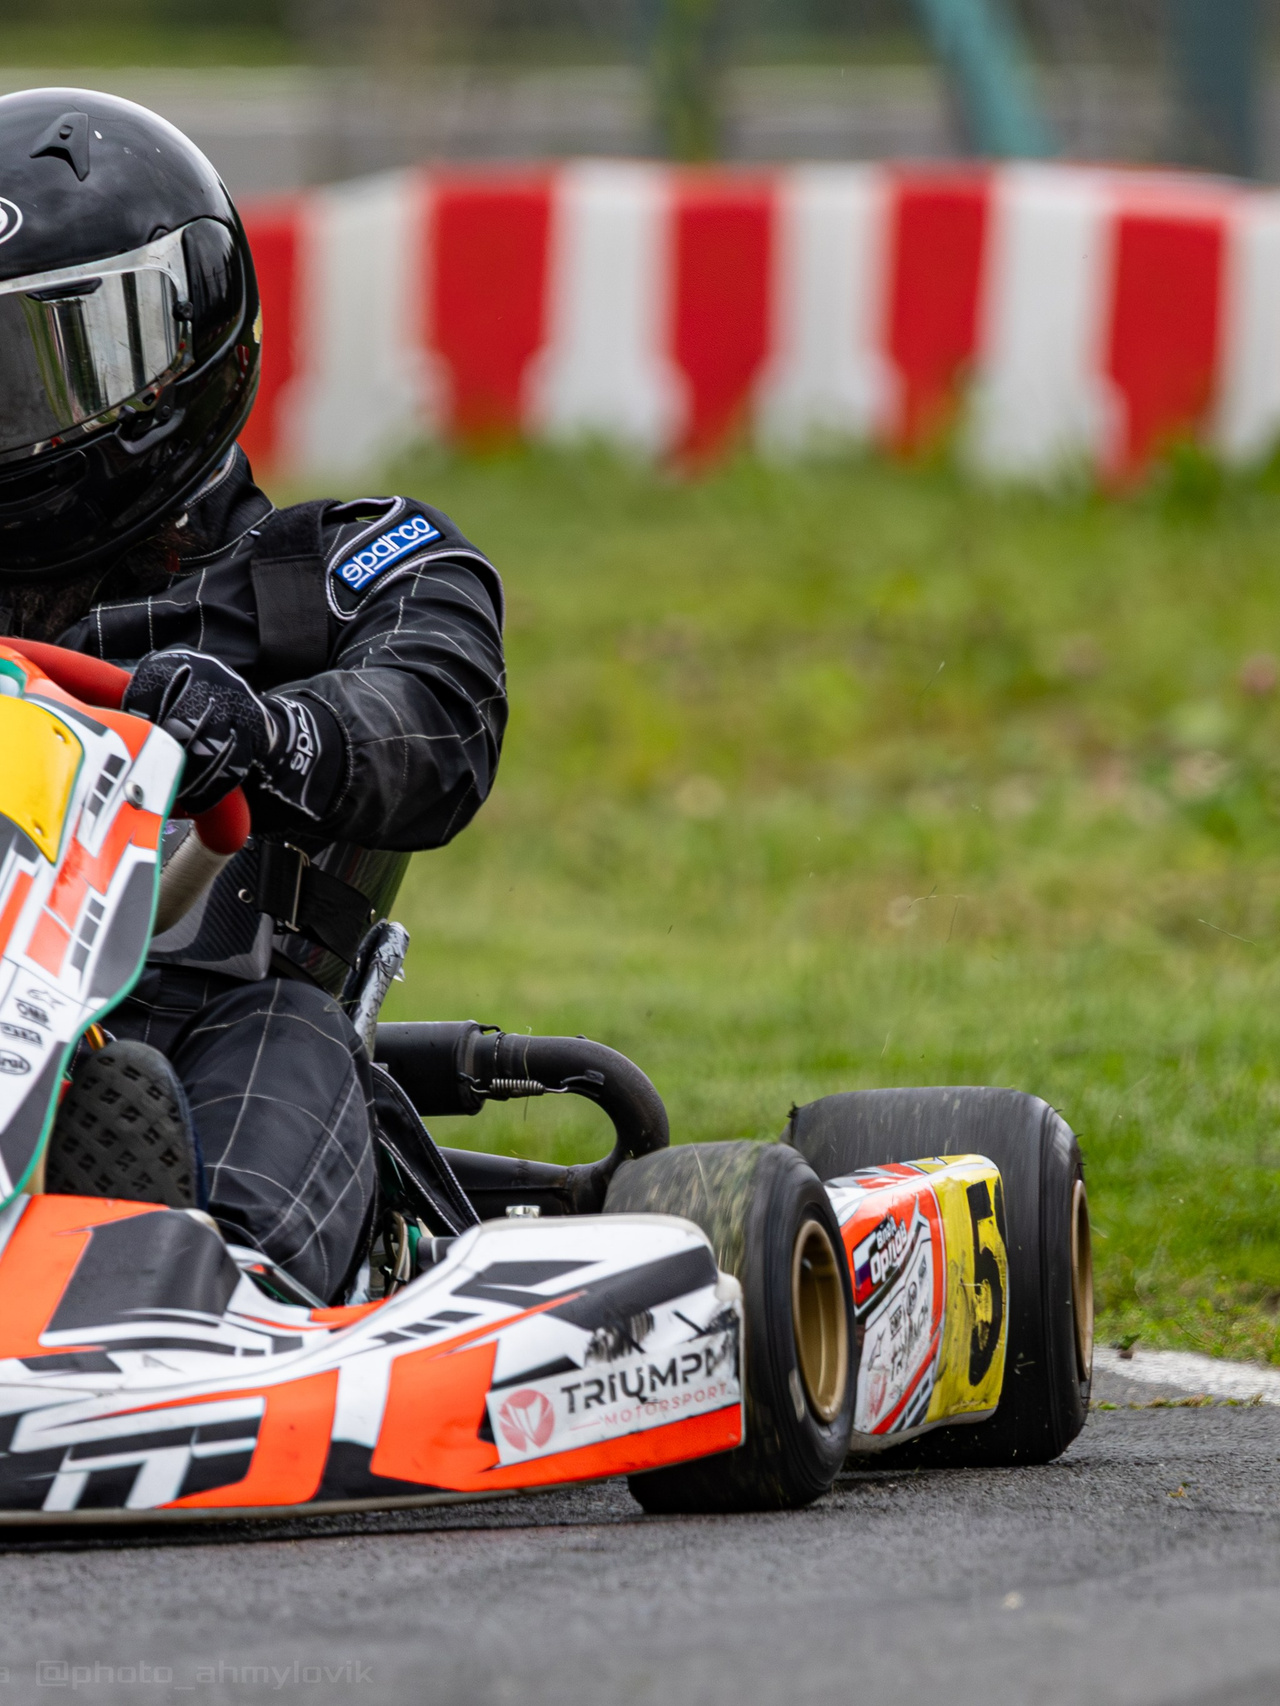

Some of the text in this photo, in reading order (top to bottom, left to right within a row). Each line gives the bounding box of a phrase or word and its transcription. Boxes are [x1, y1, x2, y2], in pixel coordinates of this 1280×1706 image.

[342, 516, 432, 585] sparco
[966, 1180, 1005, 1387] 5
[604, 1382, 728, 1426] MOTORSPORT
